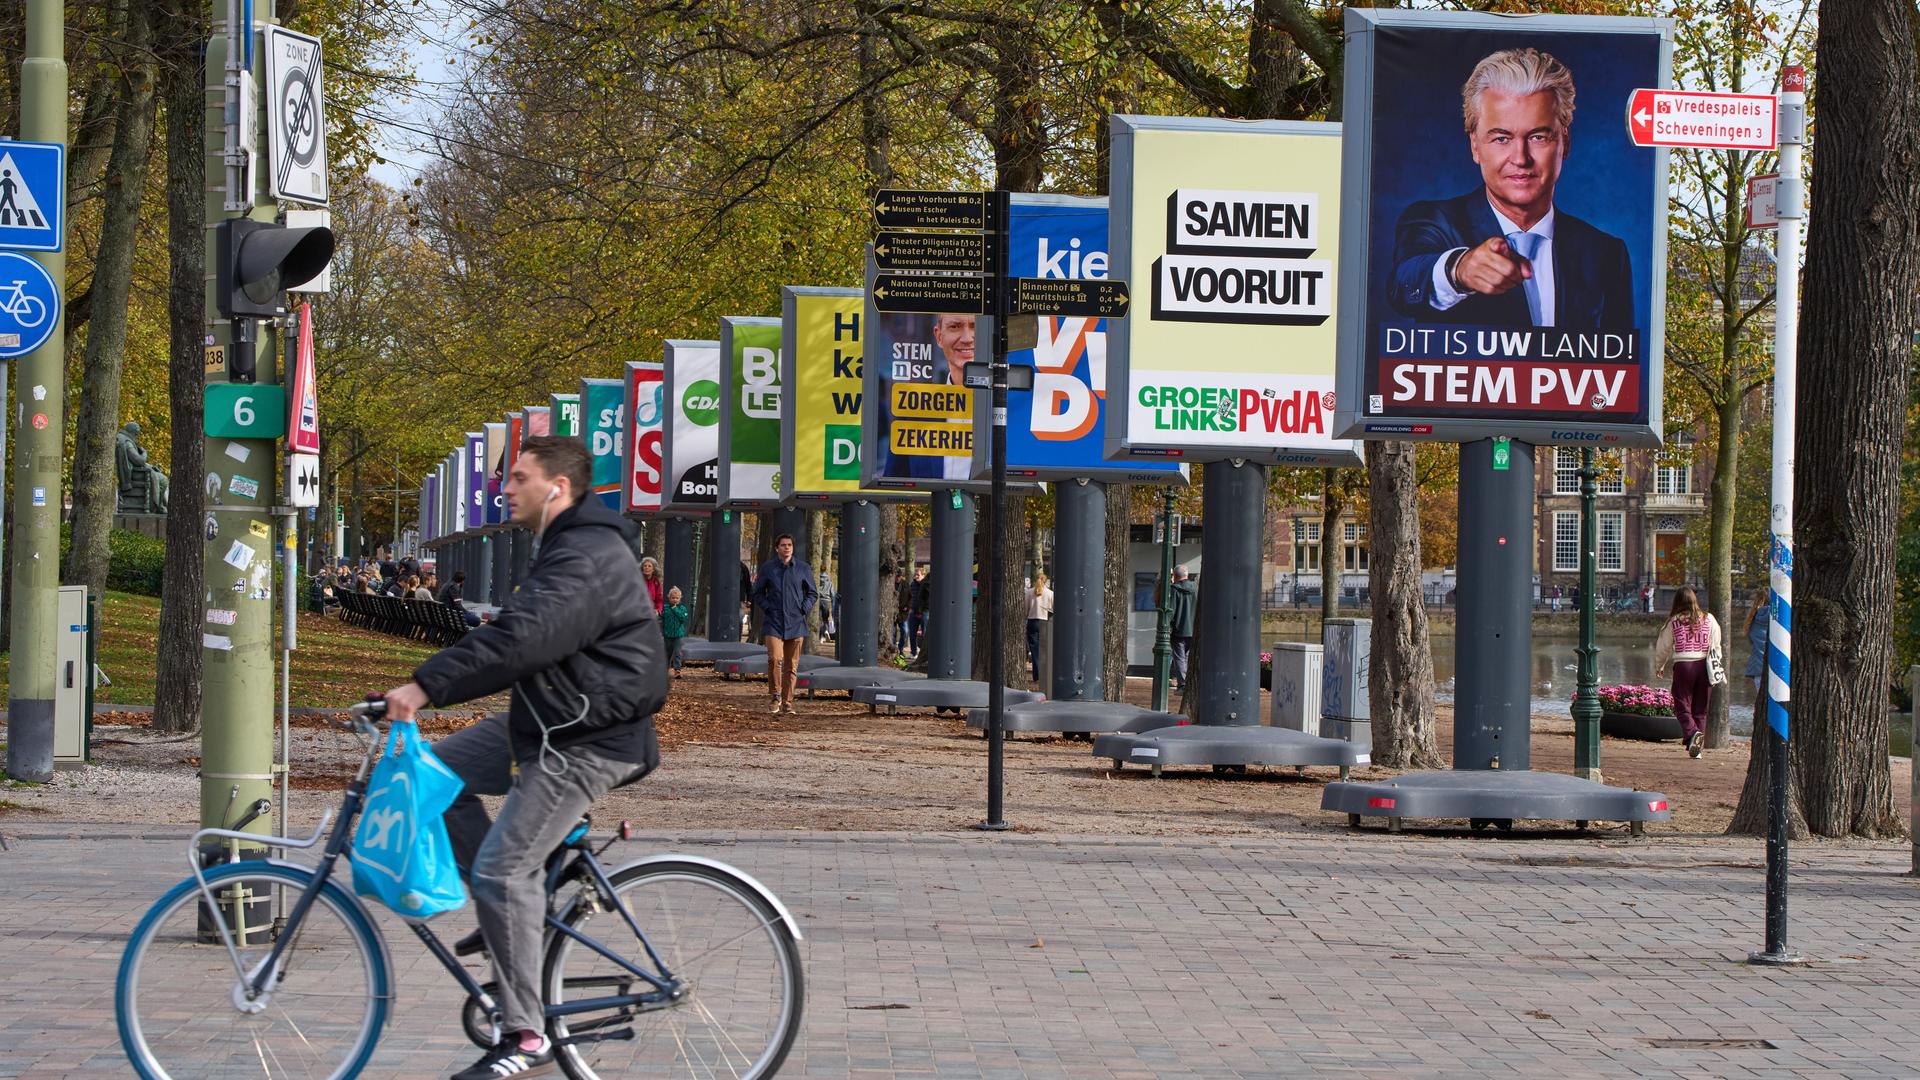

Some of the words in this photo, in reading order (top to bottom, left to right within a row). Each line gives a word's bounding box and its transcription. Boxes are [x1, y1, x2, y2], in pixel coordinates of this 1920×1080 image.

[286, 44, 308, 63] ZONE
[288, 98, 312, 137] 30
[1675, 99, 1761, 117] Vredespaleis
[1656, 121, 1751, 141] Scheveningen
[1756, 128, 1762, 139] 3
[891, 195, 916, 204] Lange
[918, 195, 957, 204] Voorhout
[969, 197, 982, 205] 0,2
[891, 205, 922, 213] Museum
[939, 216, 961, 224] Paleis
[1185, 200, 1309, 239] SAMEN
[891, 237, 921, 245] Theater
[922, 238, 960, 247] Diligentia
[891, 247, 924, 255] Theater
[927, 248, 954, 257] Pepijn
[1037, 237, 1108, 280] kie
[890, 279, 930, 288] Nationaal
[932, 280, 959, 289] Toneel
[1022, 283, 1068, 291] Binnenhof
[1170, 266, 1324, 306] VOORUIT
[890, 290, 922, 298] Centraal
[923, 290, 951, 298] Station
[1022, 292, 1075, 302] Mauritshuis
[1022, 302, 1051, 311] Politie
[834, 312, 860, 342] H
[892, 342, 932, 360] STEM
[1386, 328, 1435, 354] DIT
[1444, 330, 1468, 355] IS
[1477, 331, 1532, 357] UW
[1542, 333, 1634, 360] LAND!
[206, 350, 224, 366] 238
[742, 347, 782, 386] B
[1392, 363, 1517, 404] STEM
[1531, 367, 1627, 406] PVV
[748, 392, 781, 411] LE
[898, 390, 966, 412] ZORGEN
[1138, 385, 1238, 410] GROEN
[234, 396, 255, 426] 6
[1155, 408, 1238, 432] LINKS
[1239, 388, 1325, 435] PvdA
